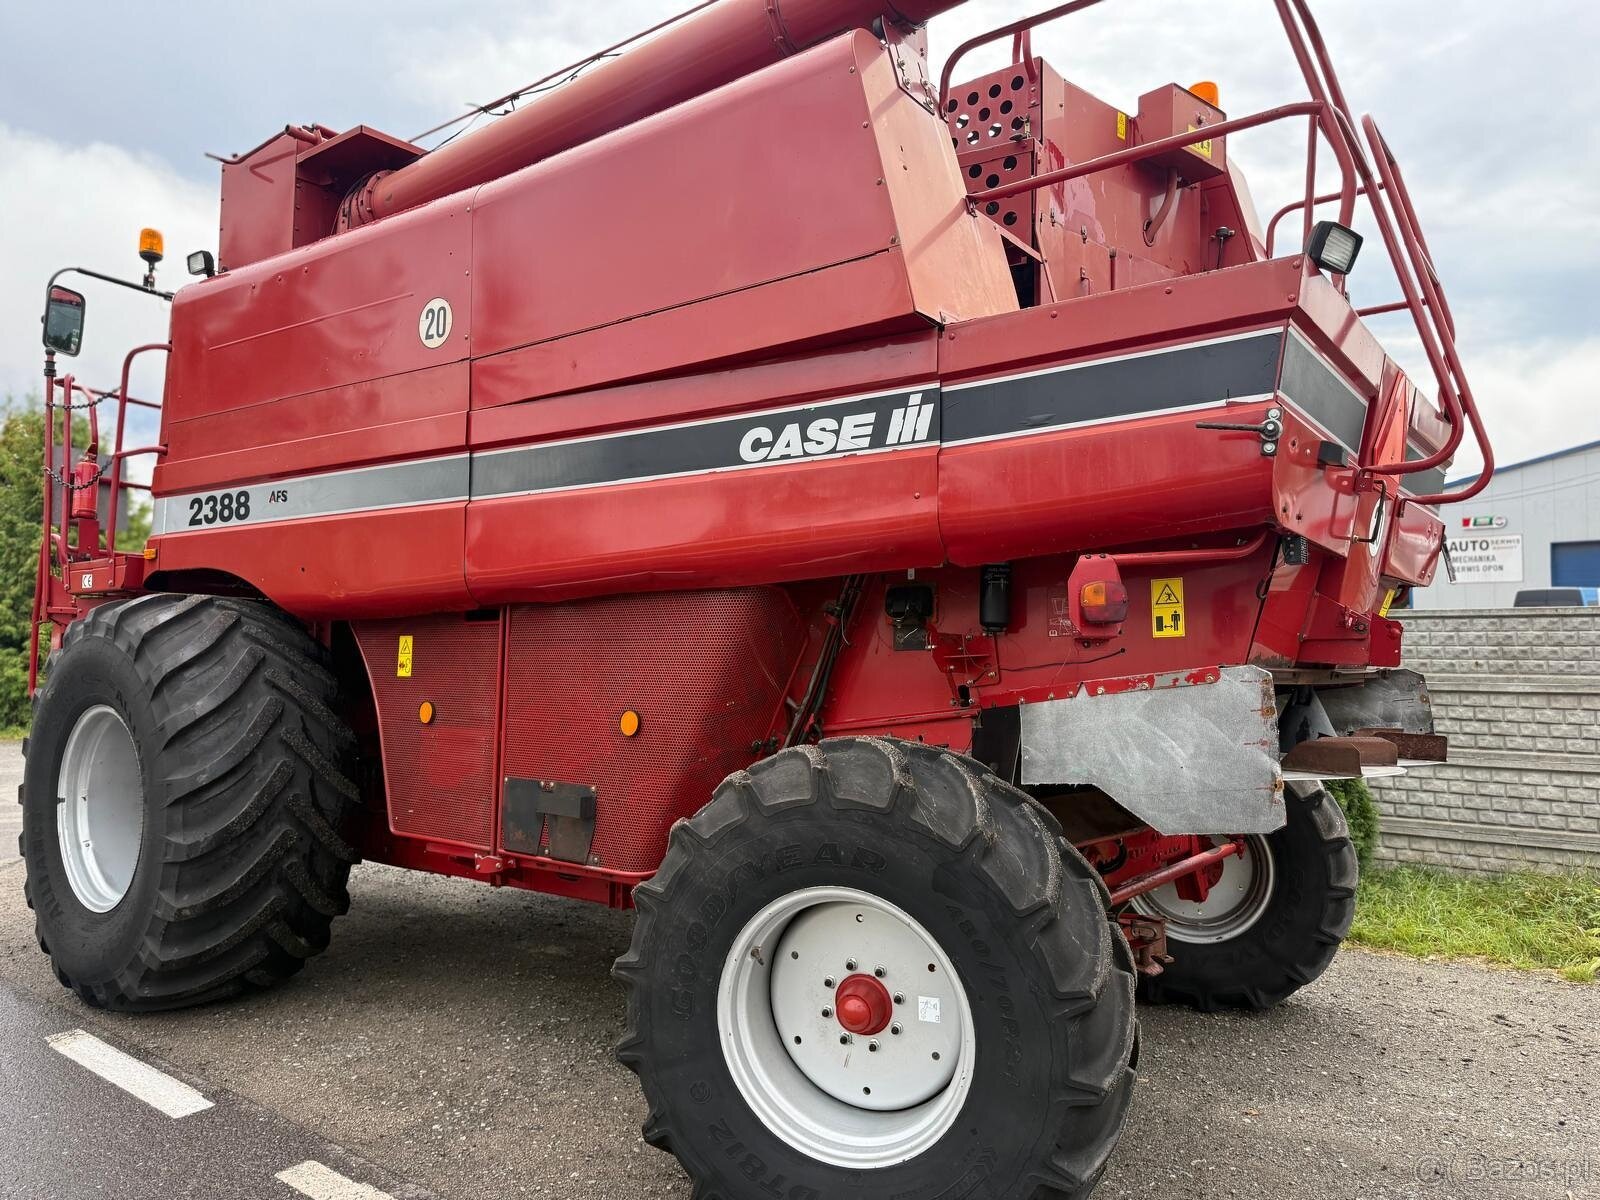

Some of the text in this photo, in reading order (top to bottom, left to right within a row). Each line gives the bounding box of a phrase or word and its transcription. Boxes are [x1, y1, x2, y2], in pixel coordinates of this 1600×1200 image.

[425, 306, 447, 340] 20
[739, 412, 876, 462] CASE
[268, 490, 288, 503] AFS
[188, 490, 250, 526] 2388
[1450, 540, 1489, 551] AUTO
[1452, 555, 1496, 563] MECHANIKA
[83, 575, 91, 587] CE
